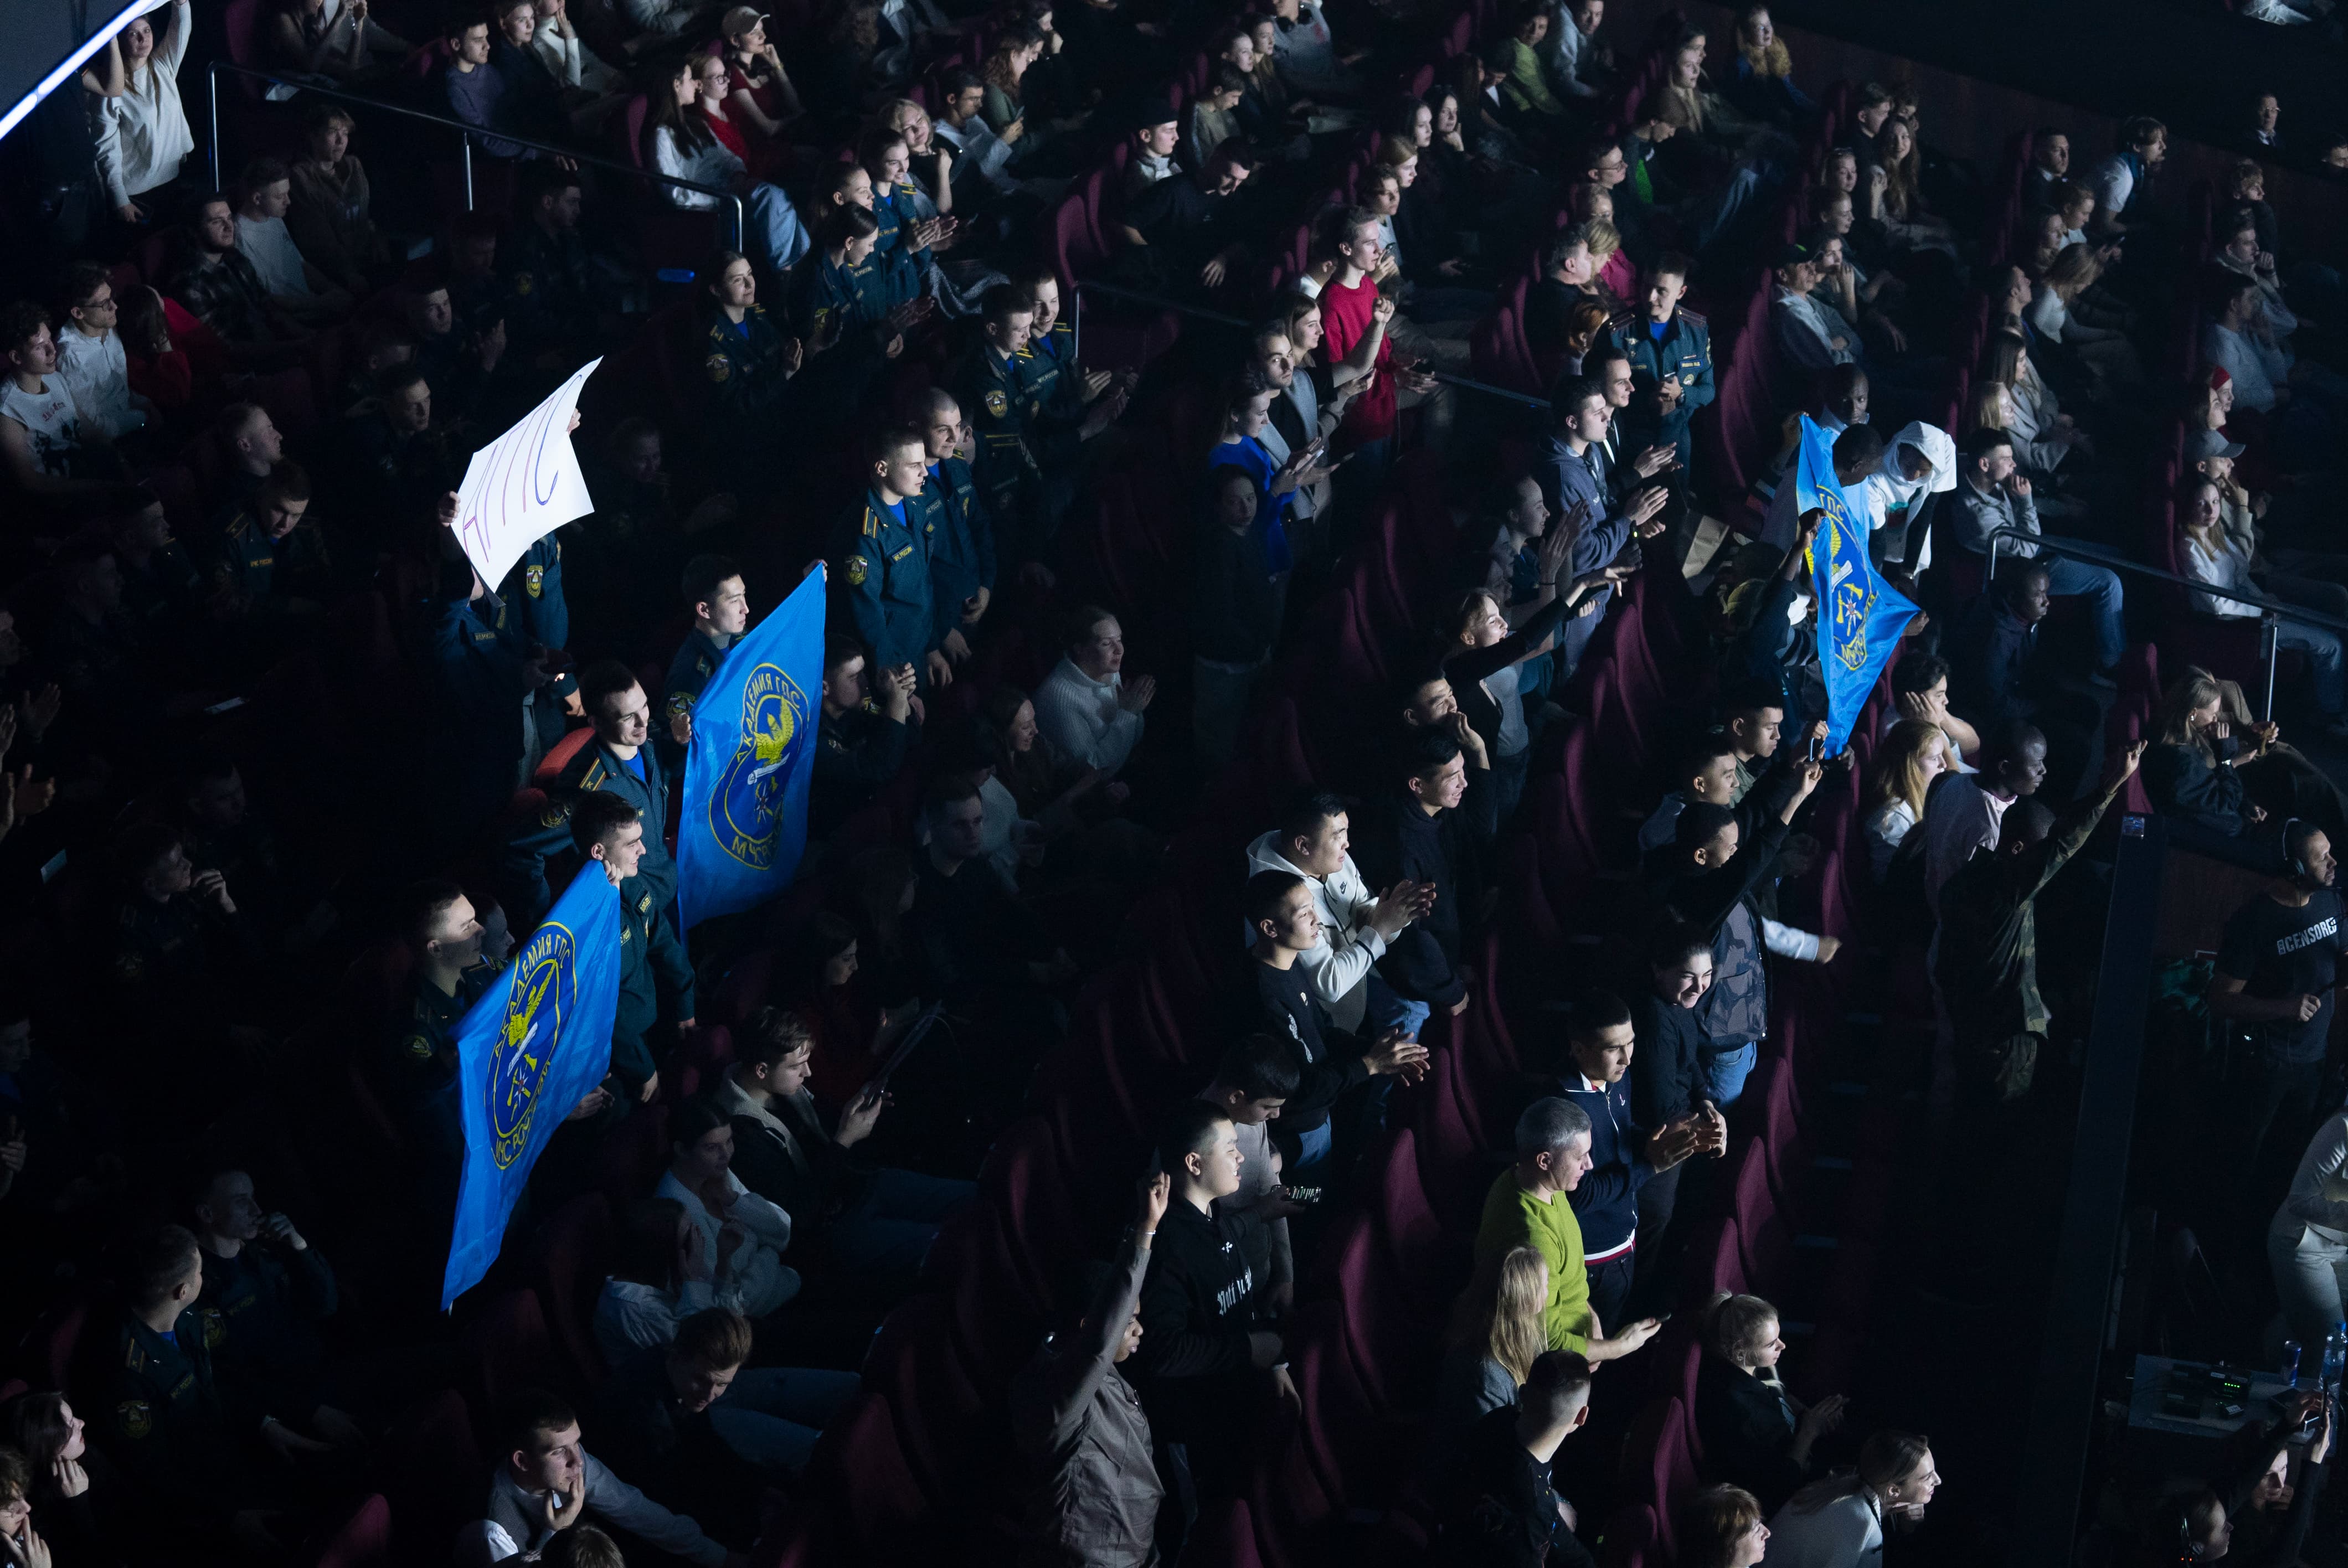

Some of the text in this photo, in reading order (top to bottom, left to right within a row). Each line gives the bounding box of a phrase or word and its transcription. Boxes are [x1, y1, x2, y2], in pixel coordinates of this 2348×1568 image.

[1820, 493, 1844, 520] ГПС
[737, 673, 800, 762] АКАДЕМИЯ ГПС
[495, 934, 570, 1058] АКАДЕМИЯ ГПС
